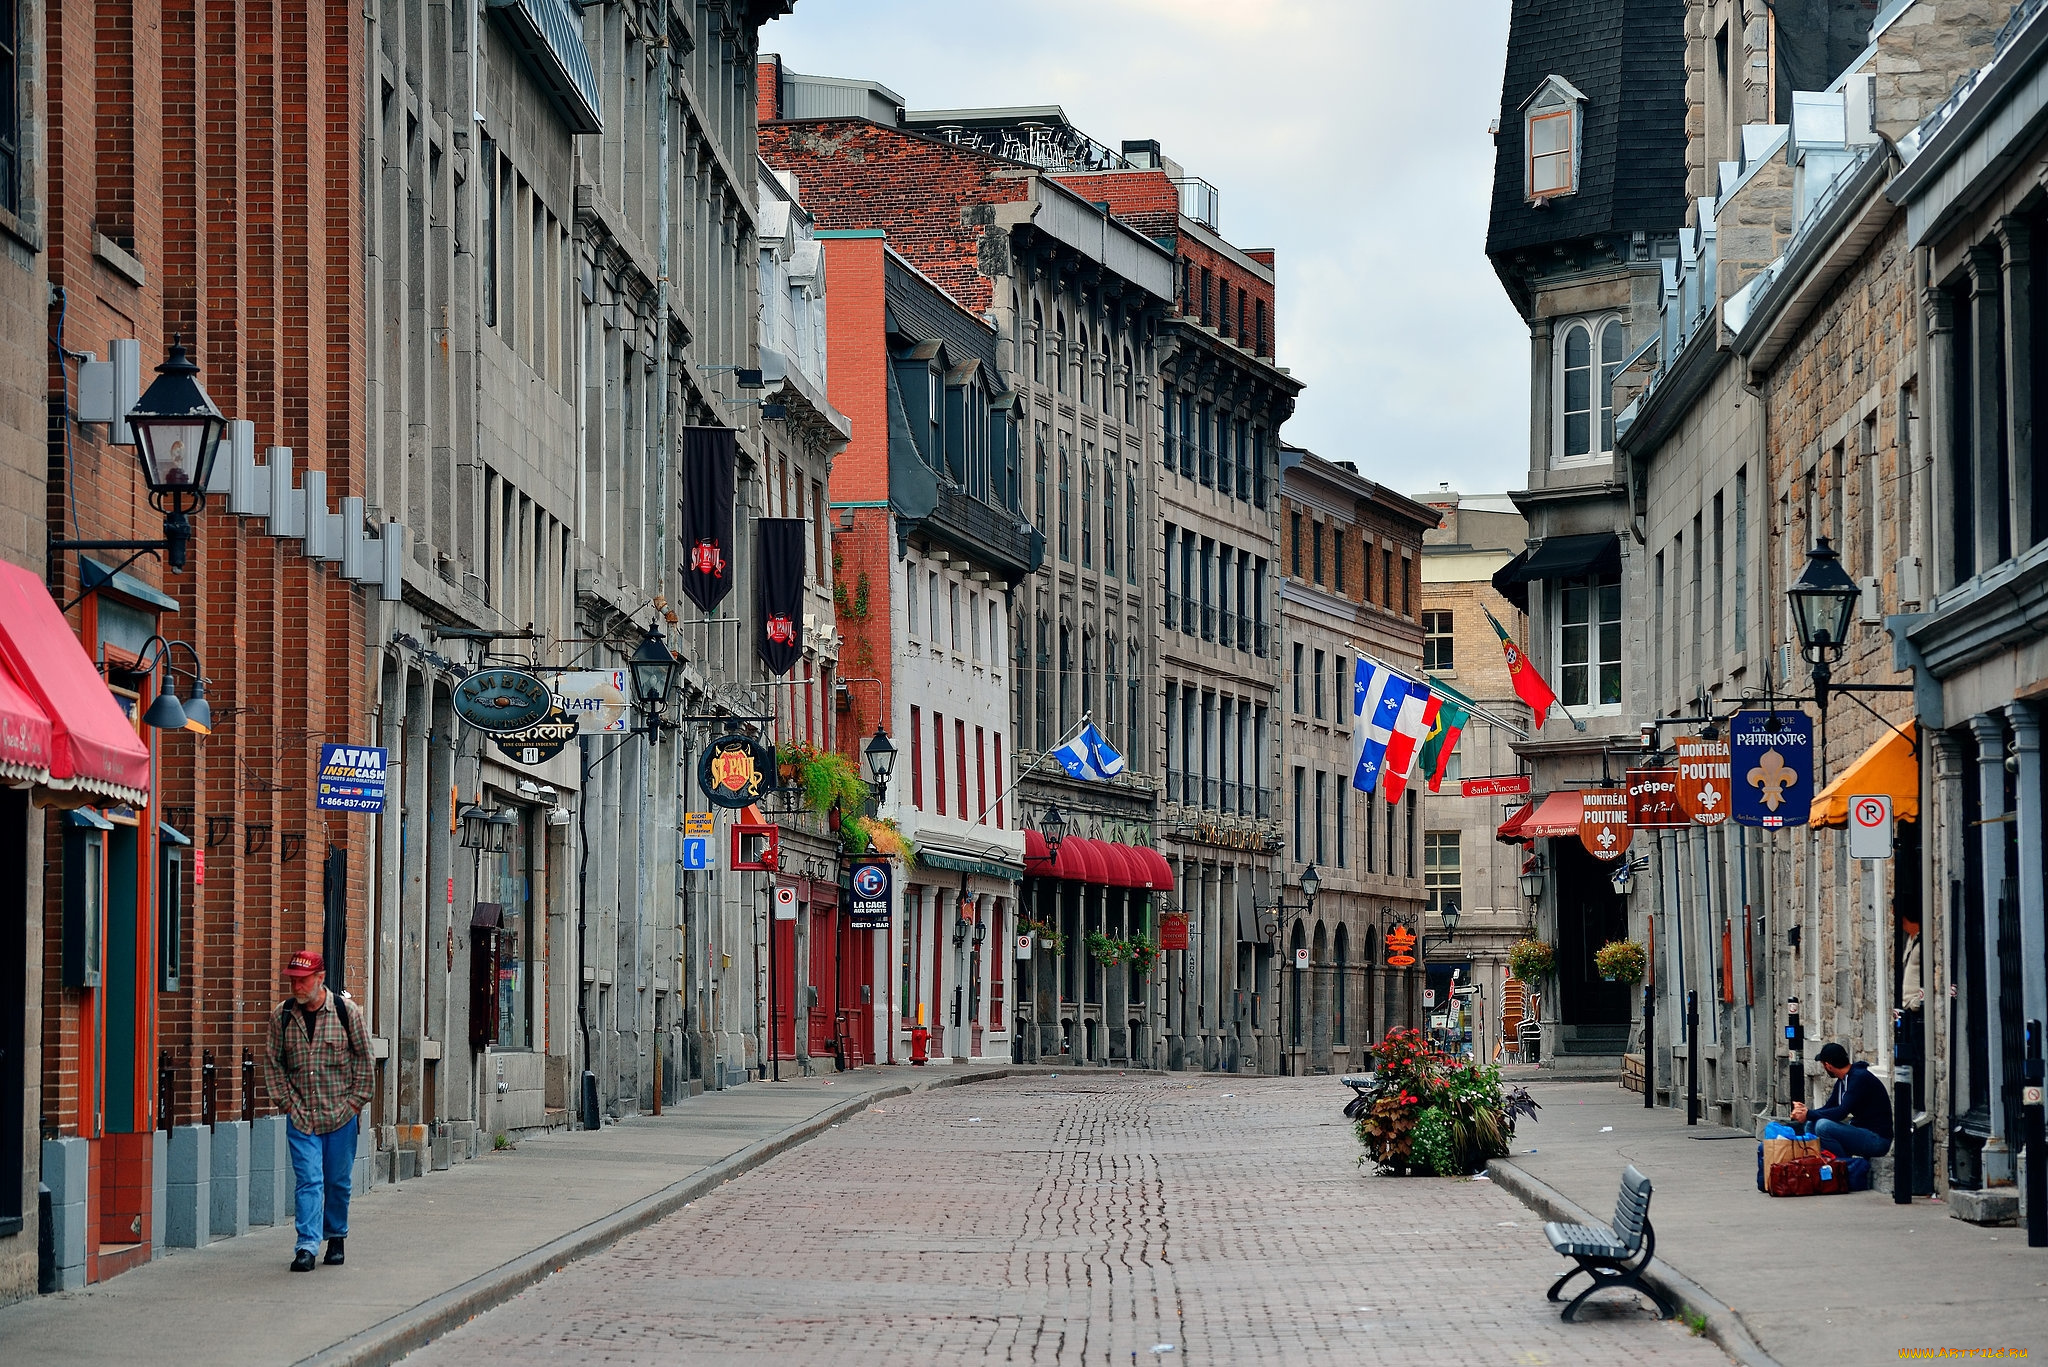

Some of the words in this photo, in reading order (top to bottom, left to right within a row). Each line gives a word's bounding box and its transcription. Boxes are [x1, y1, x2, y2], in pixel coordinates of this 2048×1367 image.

[704, 548, 722, 573] PAUL
[776, 621, 794, 642] PAUL
[463, 674, 544, 703] AMBER
[464, 708, 540, 728] BIJOUTERIE
[1680, 741, 1730, 757] MONTRÉA
[1736, 734, 1807, 746] PATRIOTE
[329, 748, 380, 768] ATM
[728, 756, 757, 790] PAUL
[1471, 784, 1521, 794] Saint-Vincent
[320, 796, 380, 810] 1-866-837-0777
[1584, 810, 1627, 824] POUTINE
